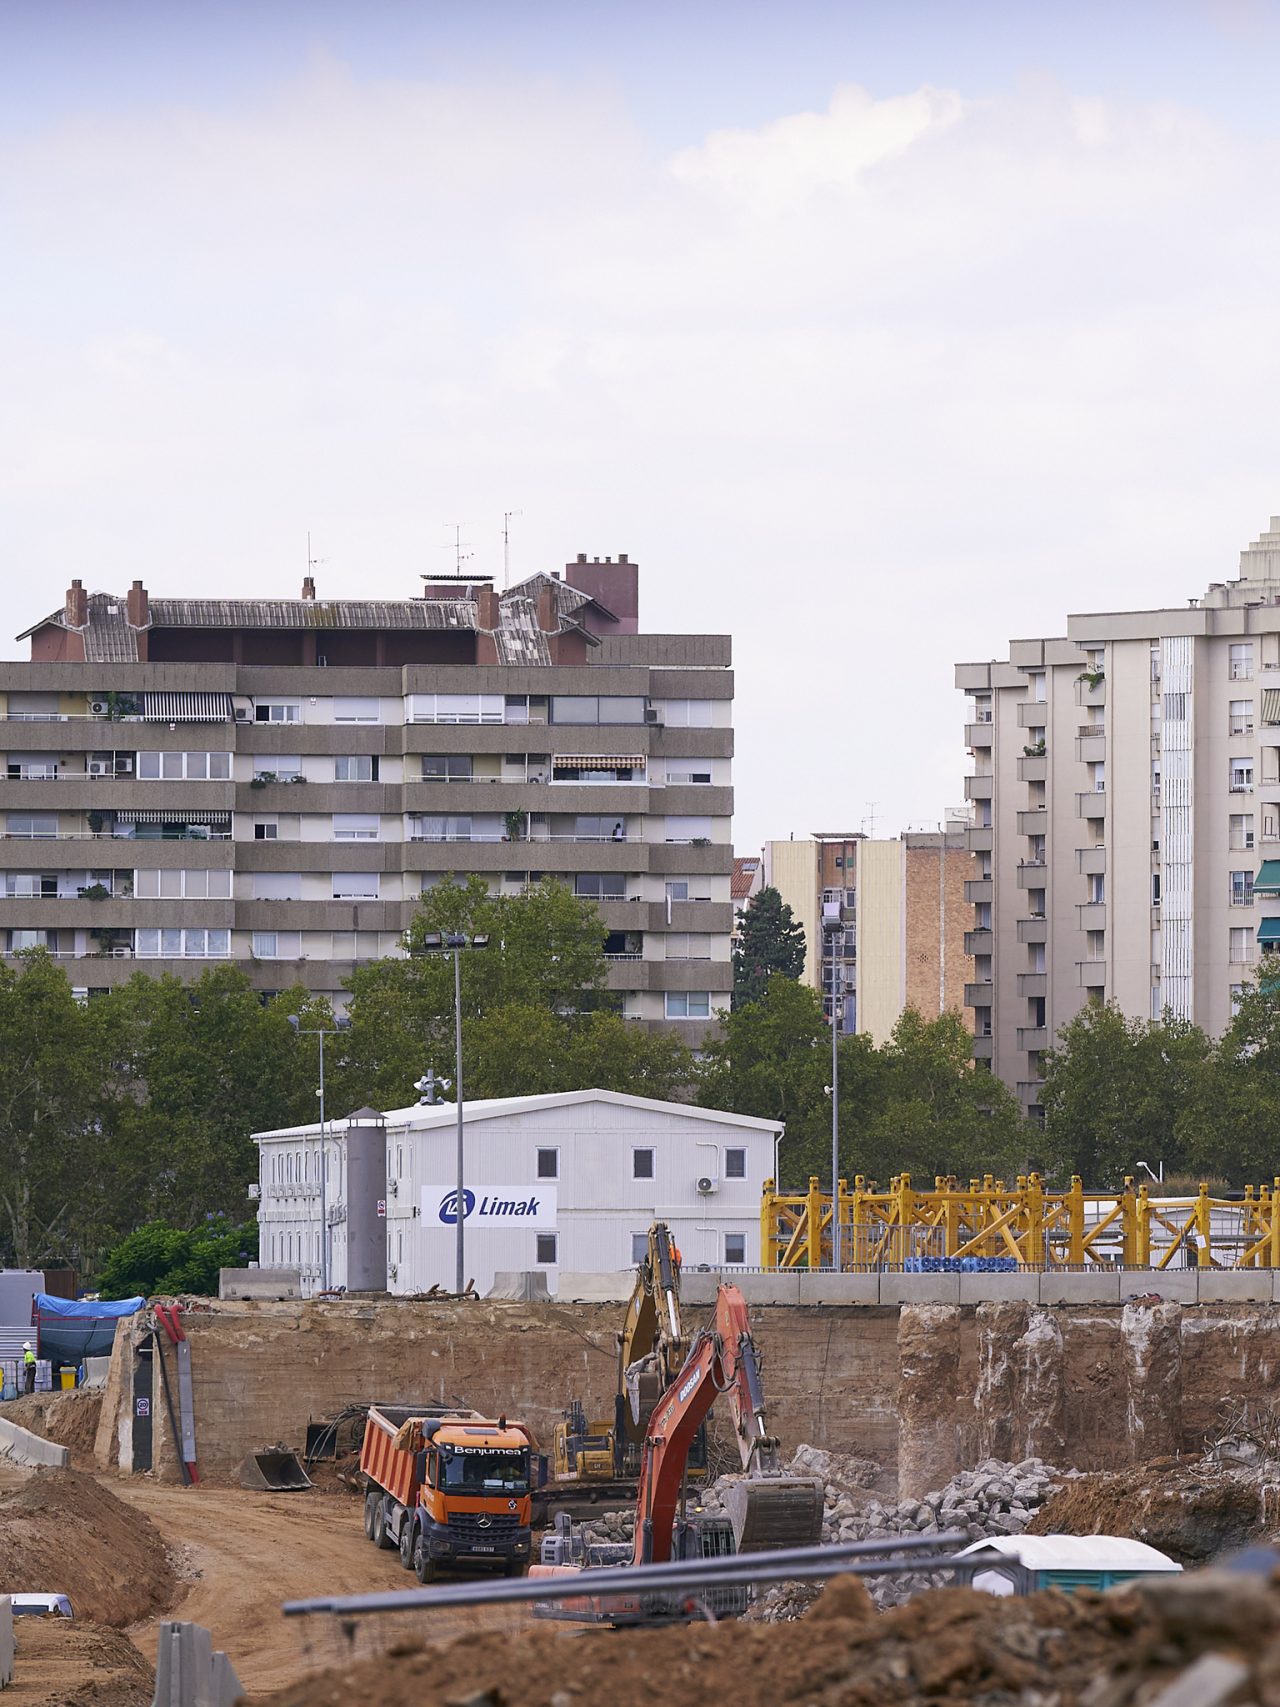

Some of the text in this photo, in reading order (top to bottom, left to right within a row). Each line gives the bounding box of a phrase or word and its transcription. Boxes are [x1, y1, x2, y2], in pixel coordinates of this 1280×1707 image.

[479, 1197, 540, 1216] Limak
[678, 1368, 701, 1402] DOOSAN
[454, 1446, 521, 1456] Benjumea
